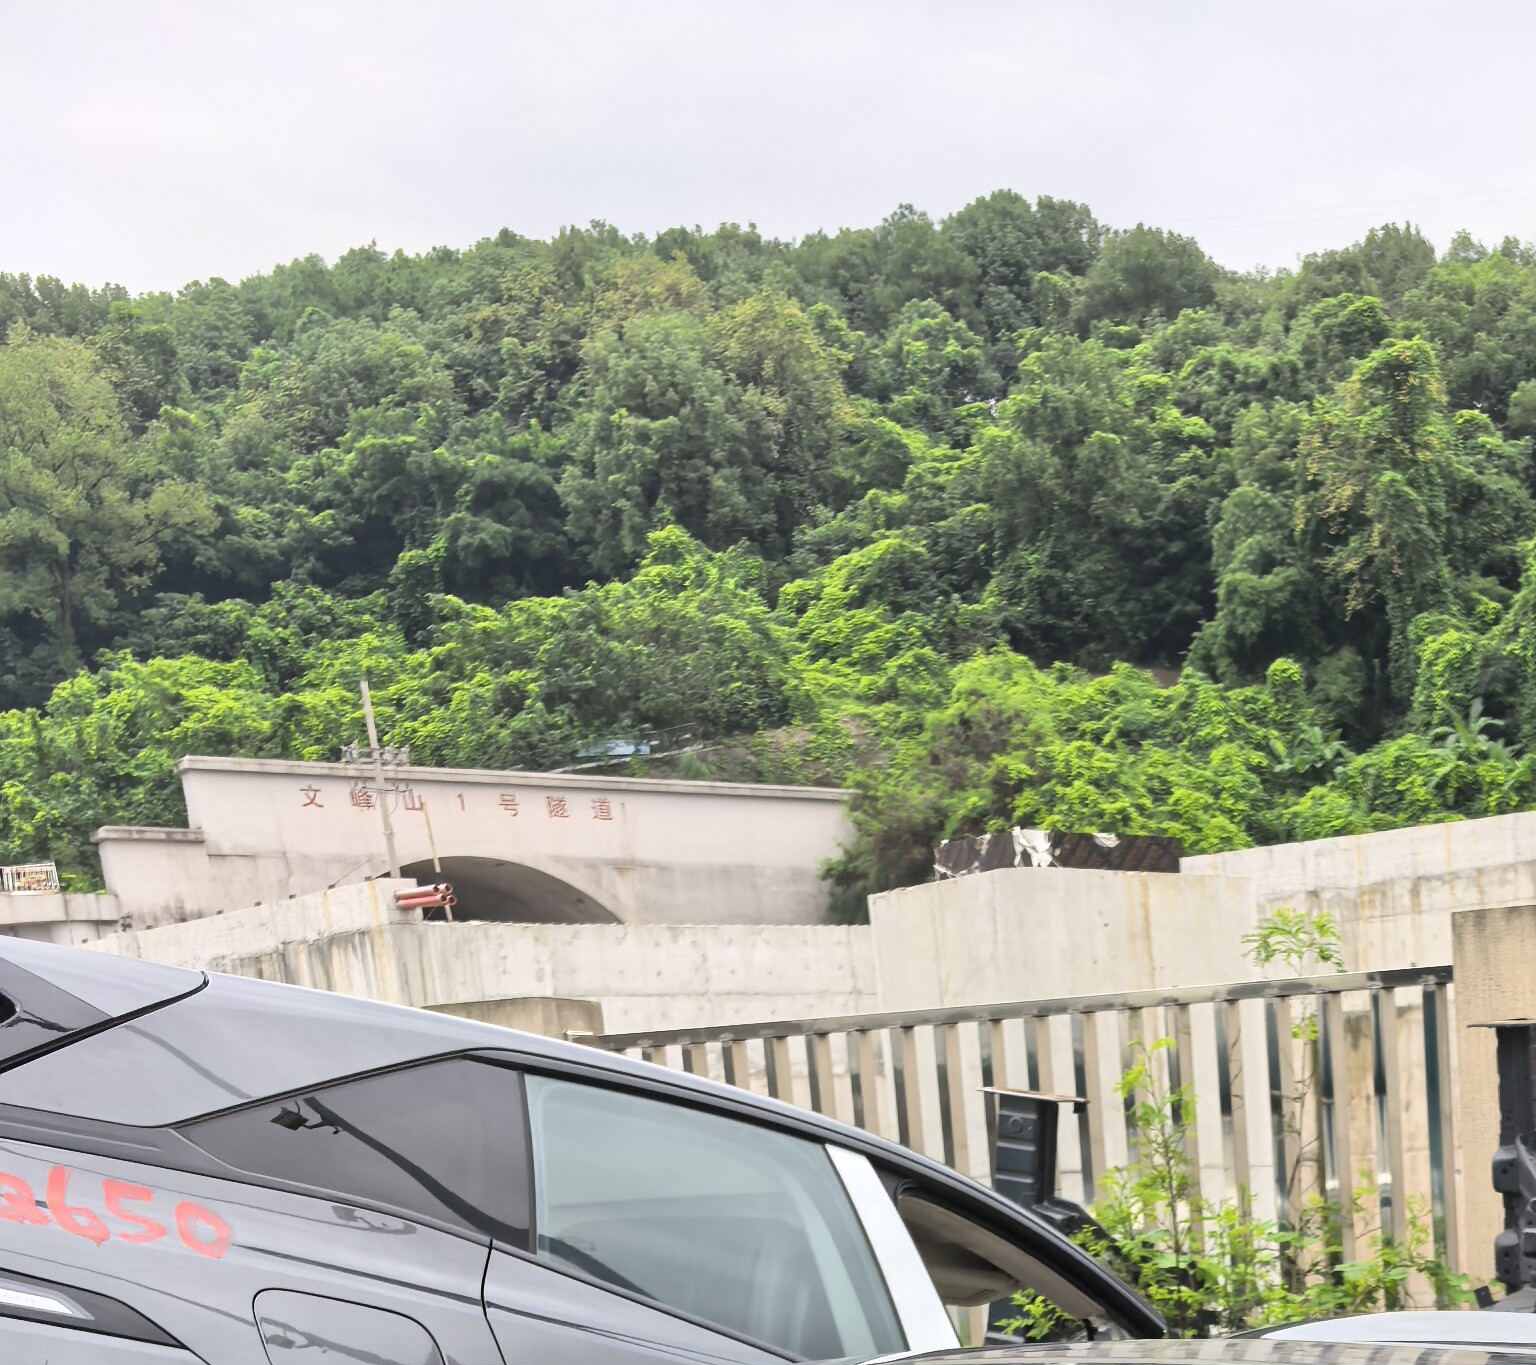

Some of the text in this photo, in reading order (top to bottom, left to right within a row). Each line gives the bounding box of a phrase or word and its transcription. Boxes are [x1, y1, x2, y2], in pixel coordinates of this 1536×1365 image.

[299, 783, 613, 821] 文峰山1号隧道
